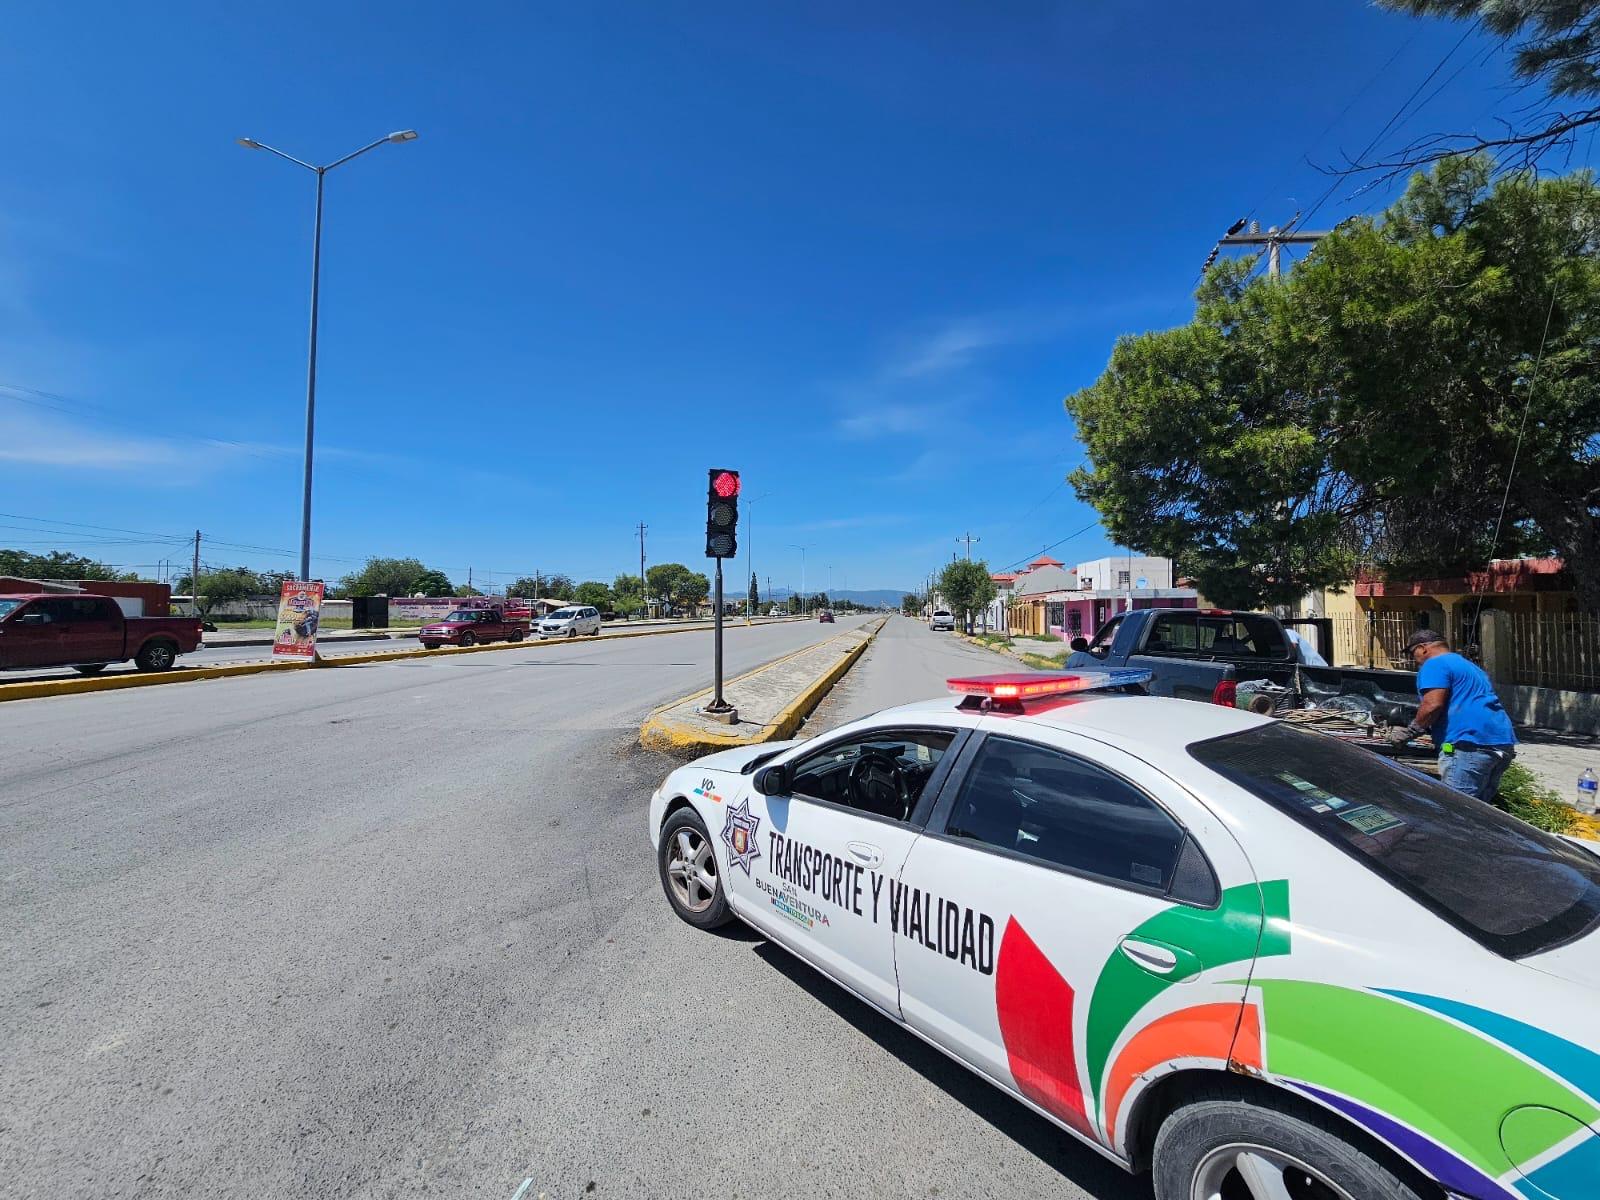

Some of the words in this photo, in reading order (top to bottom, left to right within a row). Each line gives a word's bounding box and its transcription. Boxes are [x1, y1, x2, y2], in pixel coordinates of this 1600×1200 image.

[755, 878, 831, 927] BUENAVENTURA
[769, 831, 865, 917] TRANSPORTE
[871, 871, 884, 924] Y
[889, 878, 994, 976] VIALIDAD
[782, 882, 797, 897] SAN
